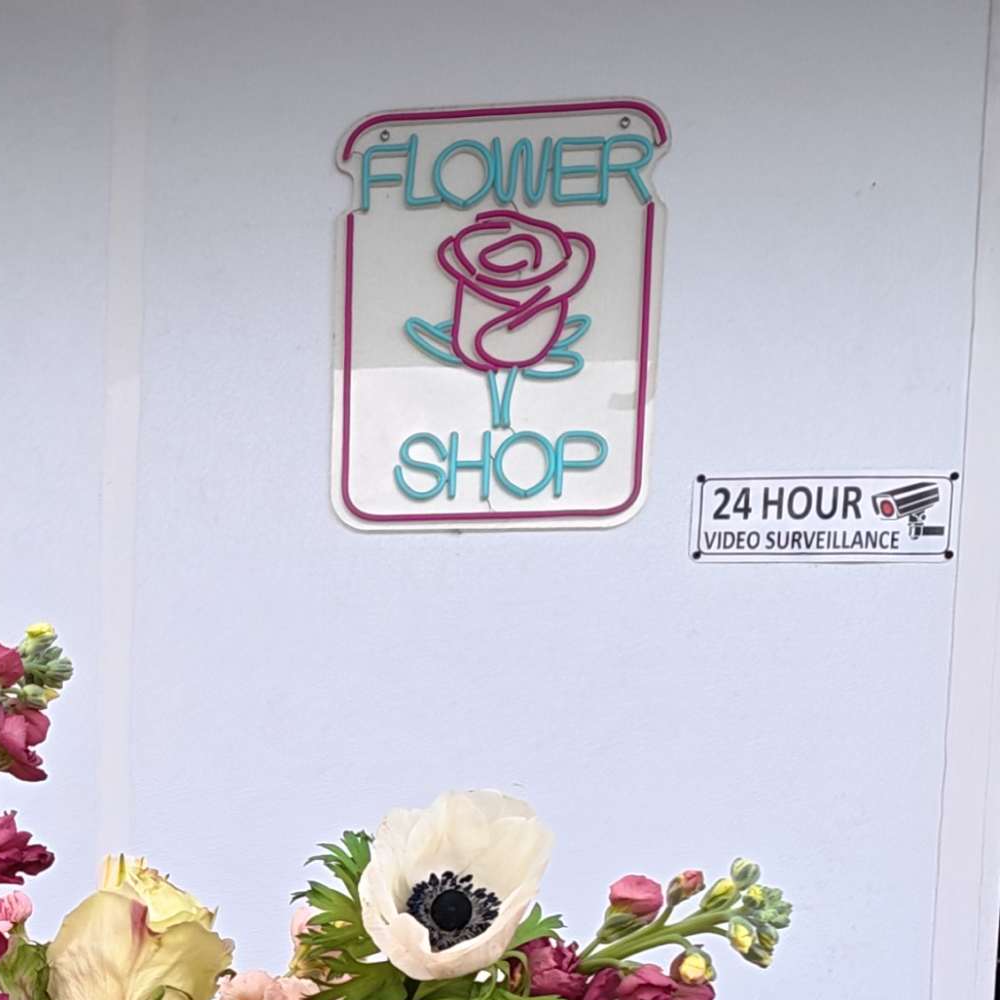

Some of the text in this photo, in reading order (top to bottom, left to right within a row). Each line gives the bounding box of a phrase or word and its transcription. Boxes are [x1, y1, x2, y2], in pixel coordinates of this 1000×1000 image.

[361, 134, 654, 211] FLOWER
[394, 431, 608, 500] SHOP
[712, 486, 862, 520] 24 HOUR
[704, 531, 900, 550] VIDEO SURVEILLANCE
